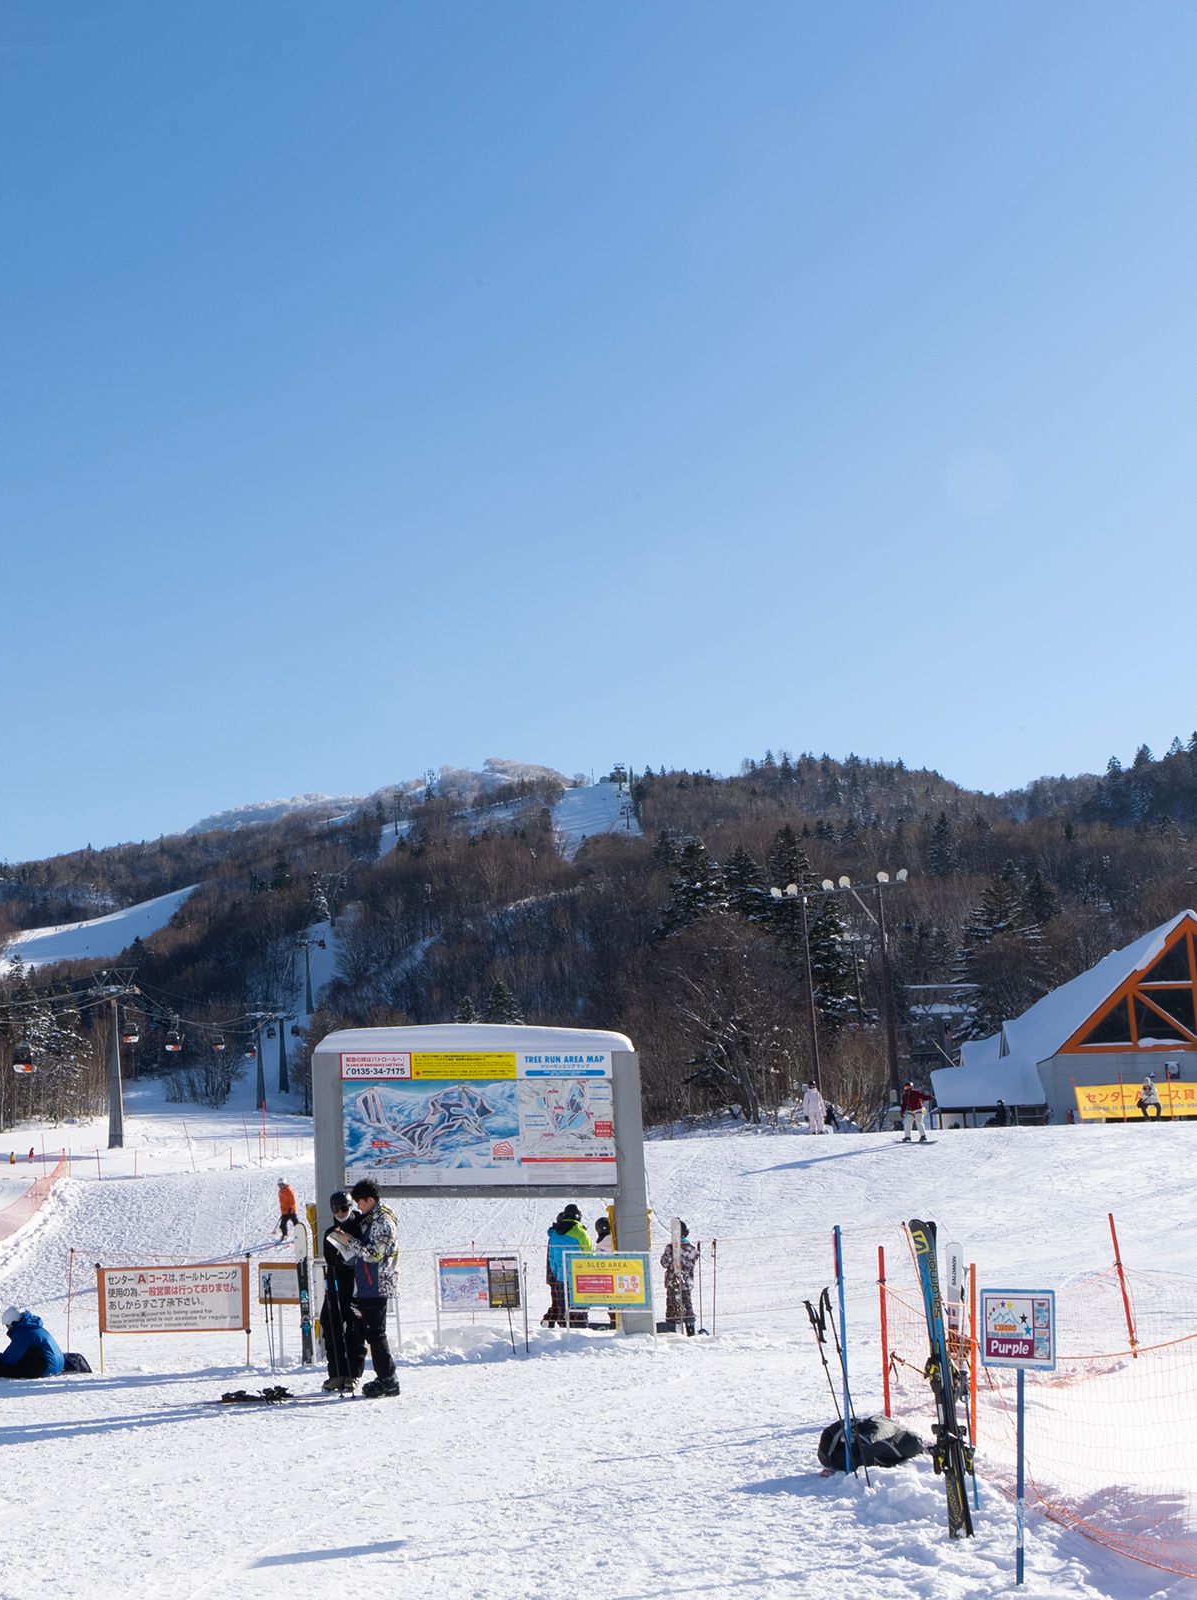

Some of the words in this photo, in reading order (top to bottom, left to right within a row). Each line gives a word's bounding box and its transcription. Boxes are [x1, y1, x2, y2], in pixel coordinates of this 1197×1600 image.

[524, 1055, 542, 1064] TREE
[544, 1055, 561, 1064] RUN
[563, 1055, 584, 1064] AREA
[586, 1055, 605, 1063] MAP
[351, 1067, 406, 1075] 0135-34-7175
[108, 1275, 135, 1286] センター
[137, 1273, 147, 1284] A
[991, 1340, 1030, 1356] Purple
